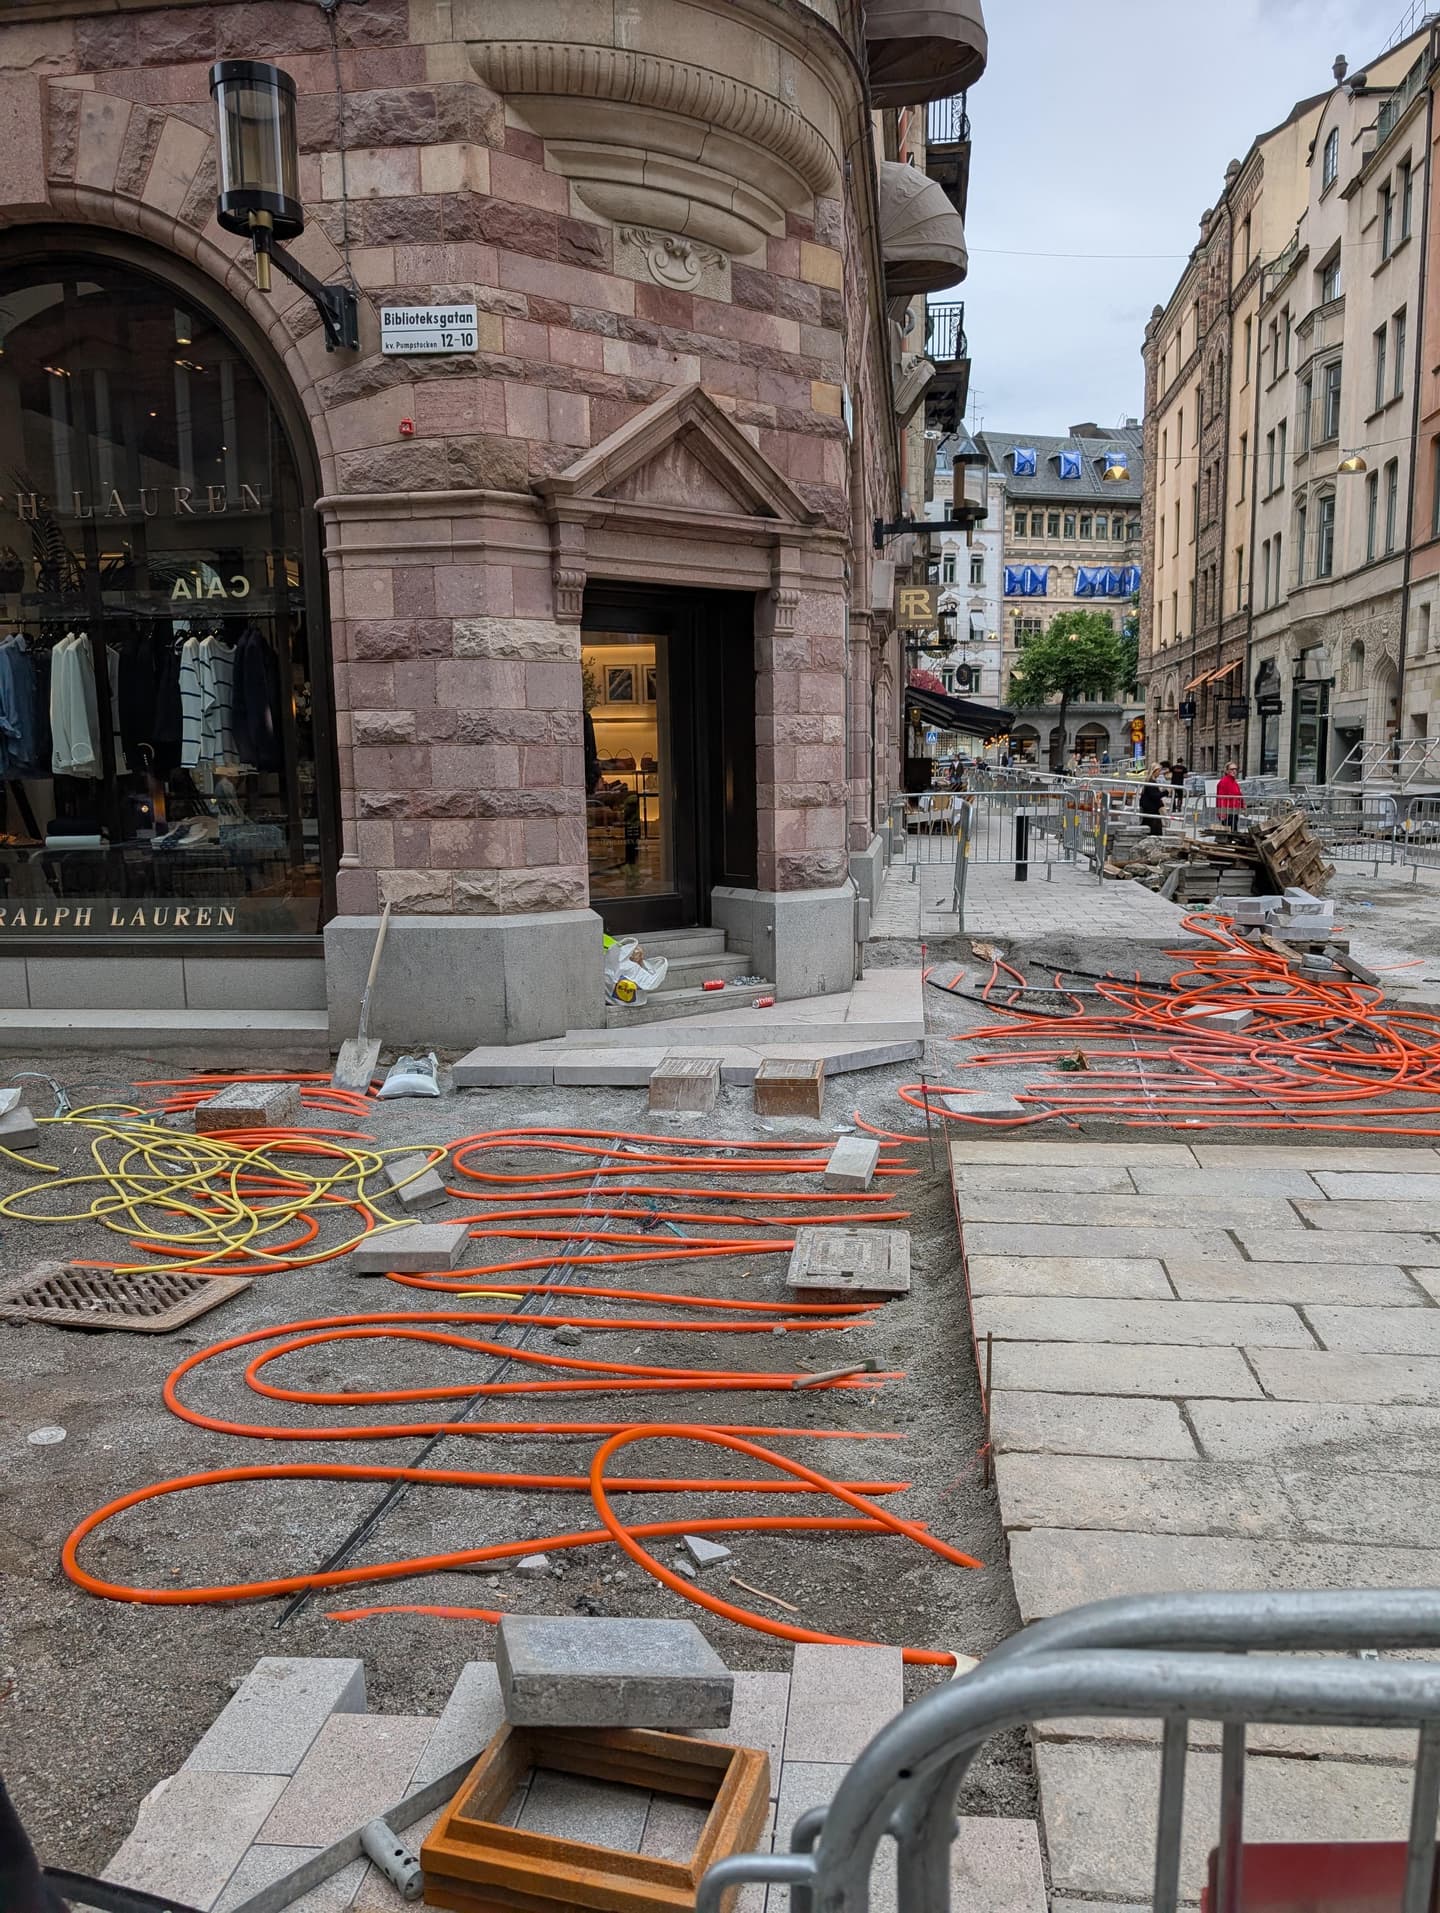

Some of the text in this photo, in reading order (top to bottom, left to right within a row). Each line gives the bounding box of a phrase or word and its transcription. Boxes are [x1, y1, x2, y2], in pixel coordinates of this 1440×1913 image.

[384, 312, 473, 328] Biblioteksgatan
[385, 342, 395, 350] kv.
[71, 483, 264, 519] LAUREN
[110, 906, 237, 927] LAUREN
